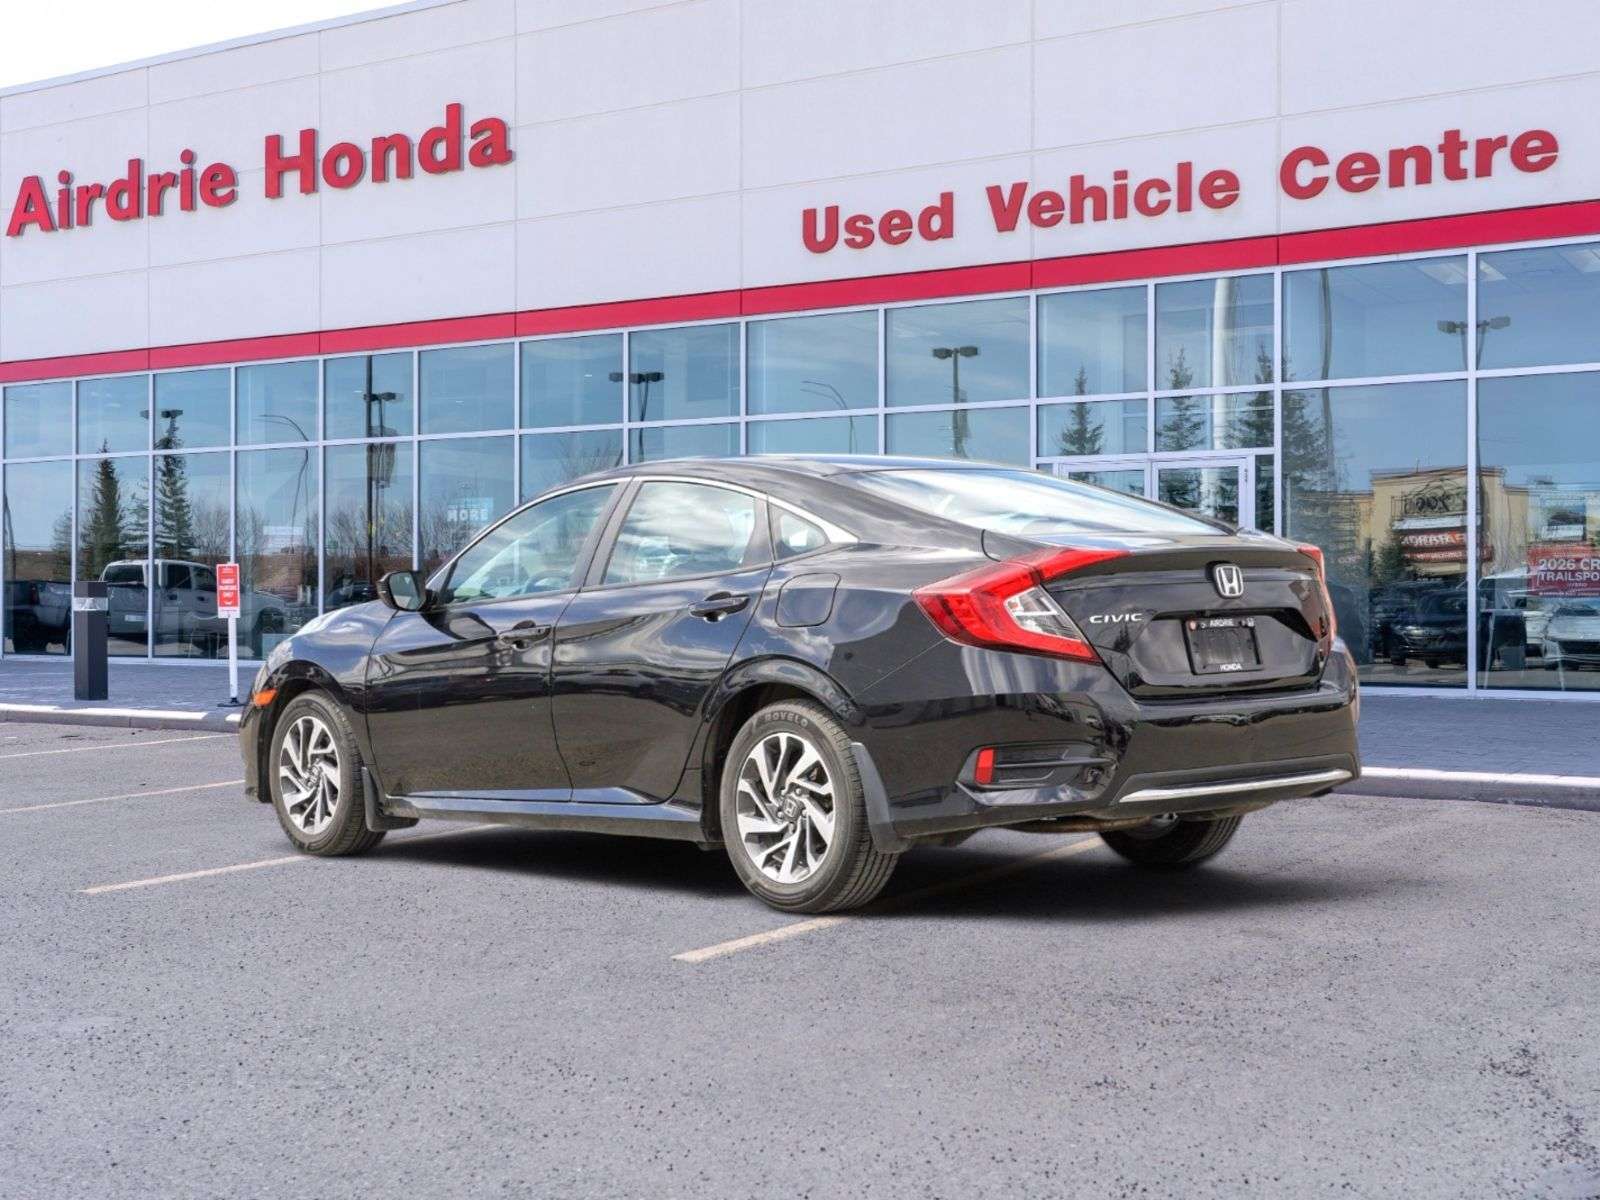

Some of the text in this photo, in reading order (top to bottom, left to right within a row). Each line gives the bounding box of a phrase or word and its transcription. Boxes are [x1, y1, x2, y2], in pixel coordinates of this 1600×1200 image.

[6, 102, 513, 237] Airdrie Honda
[802, 129, 1559, 254] Used Vehicle Centre
[1539, 558, 1576, 571] 2026
[1089, 613, 1143, 624] CIVIC
